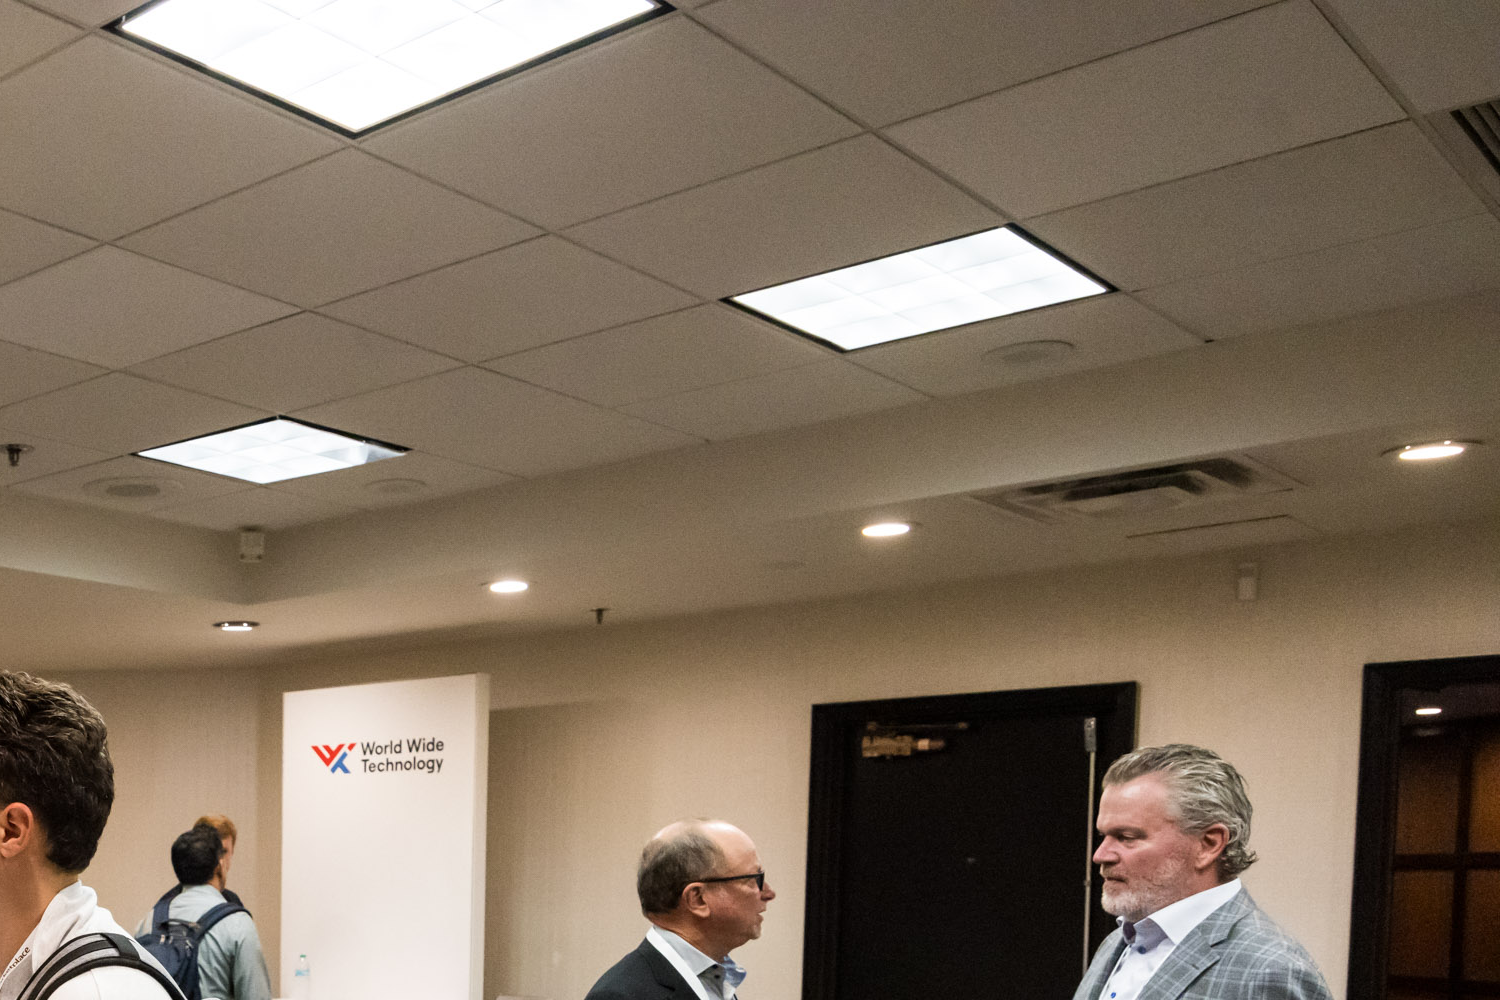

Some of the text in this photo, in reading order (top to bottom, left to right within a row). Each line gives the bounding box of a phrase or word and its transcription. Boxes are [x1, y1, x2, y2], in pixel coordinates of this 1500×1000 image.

[361, 737, 444, 756] World Wide
[361, 756, 444, 773] Technology
